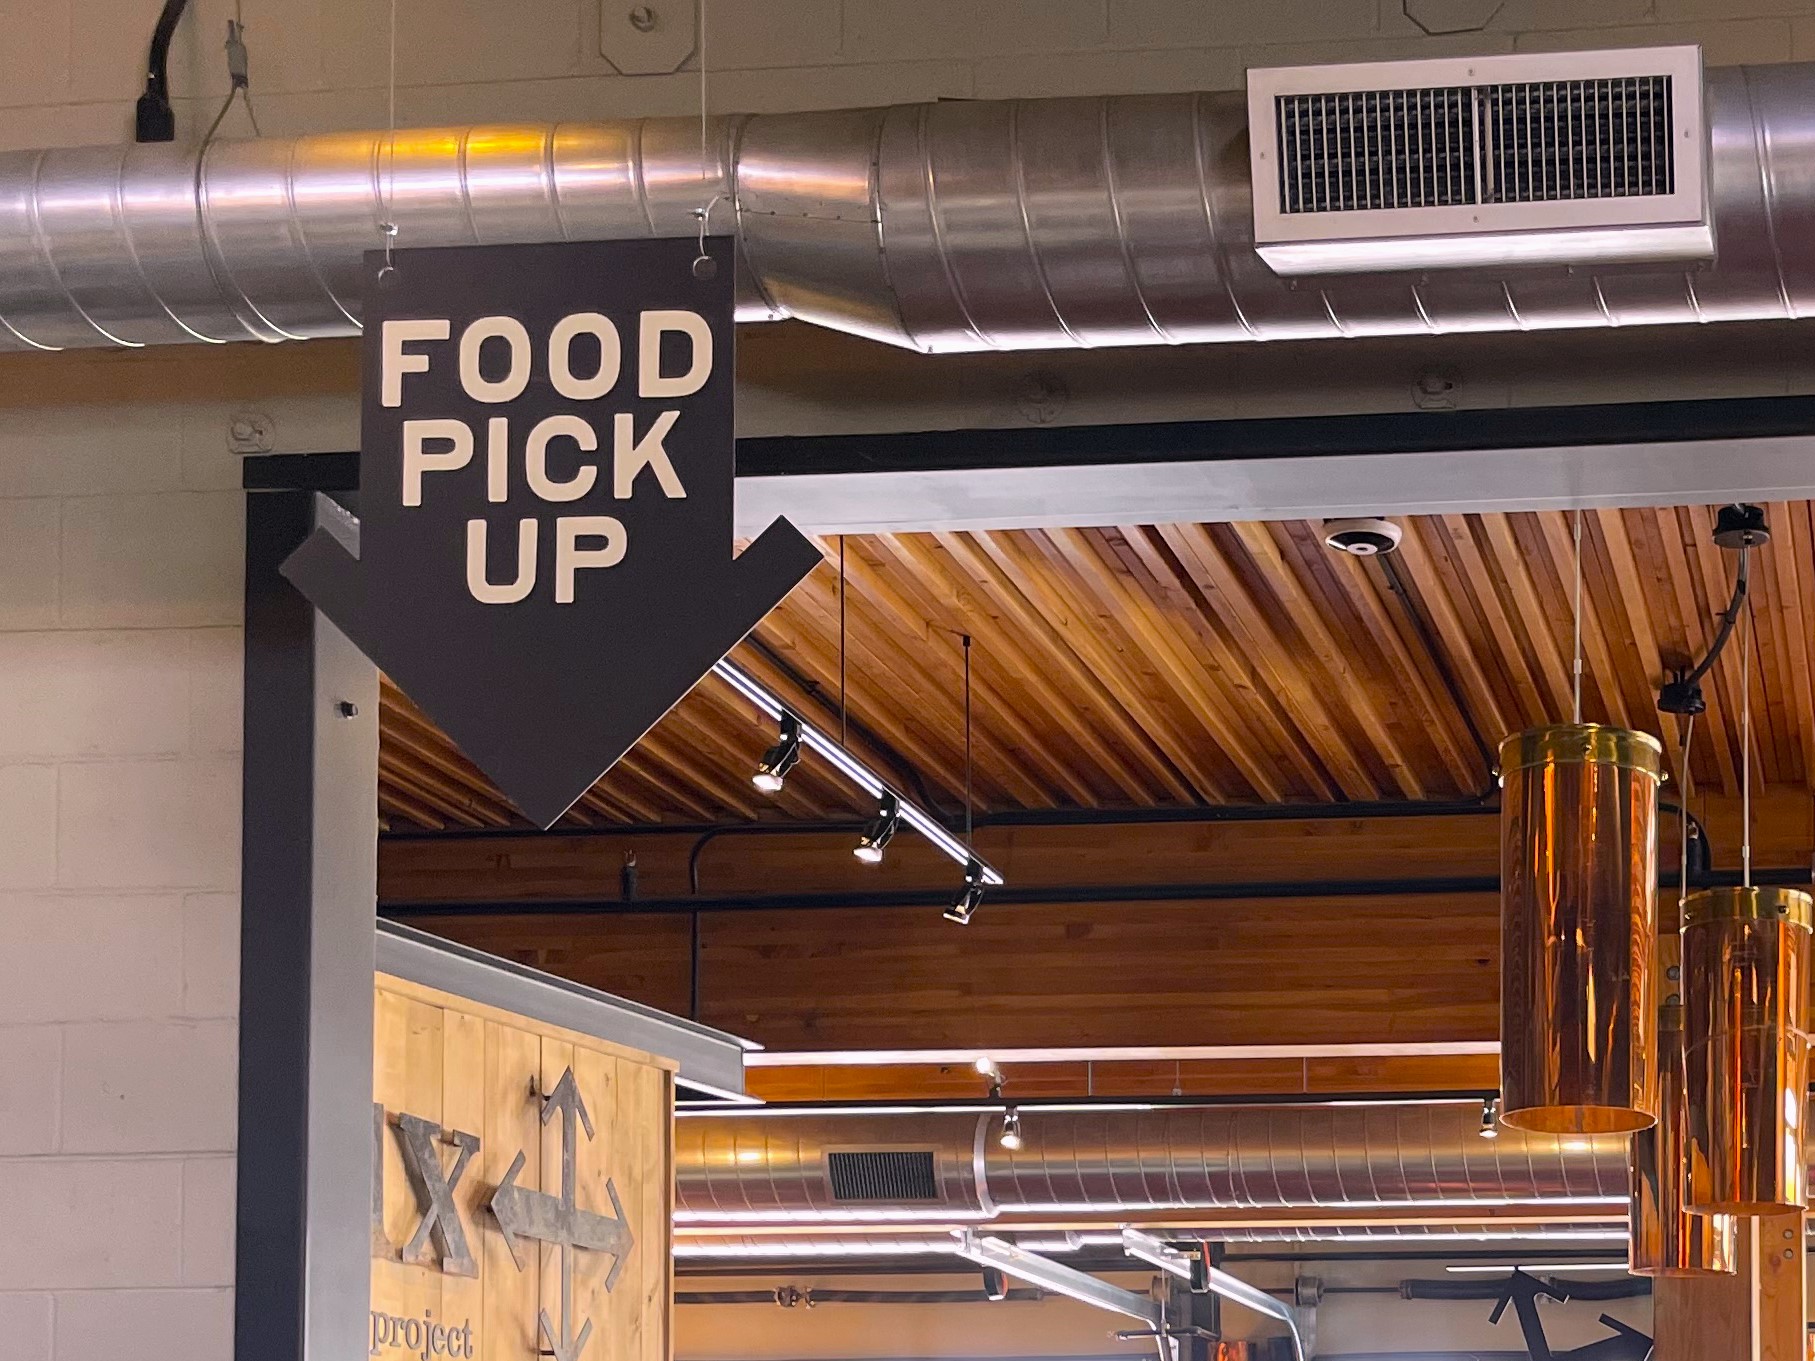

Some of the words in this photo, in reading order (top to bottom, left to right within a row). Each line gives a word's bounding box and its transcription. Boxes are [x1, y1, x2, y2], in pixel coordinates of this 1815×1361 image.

[381, 310, 713, 407] FOOD
[401, 410, 687, 506] PICK
[466, 515, 628, 604] UP
[372, 1102, 481, 1280] X
